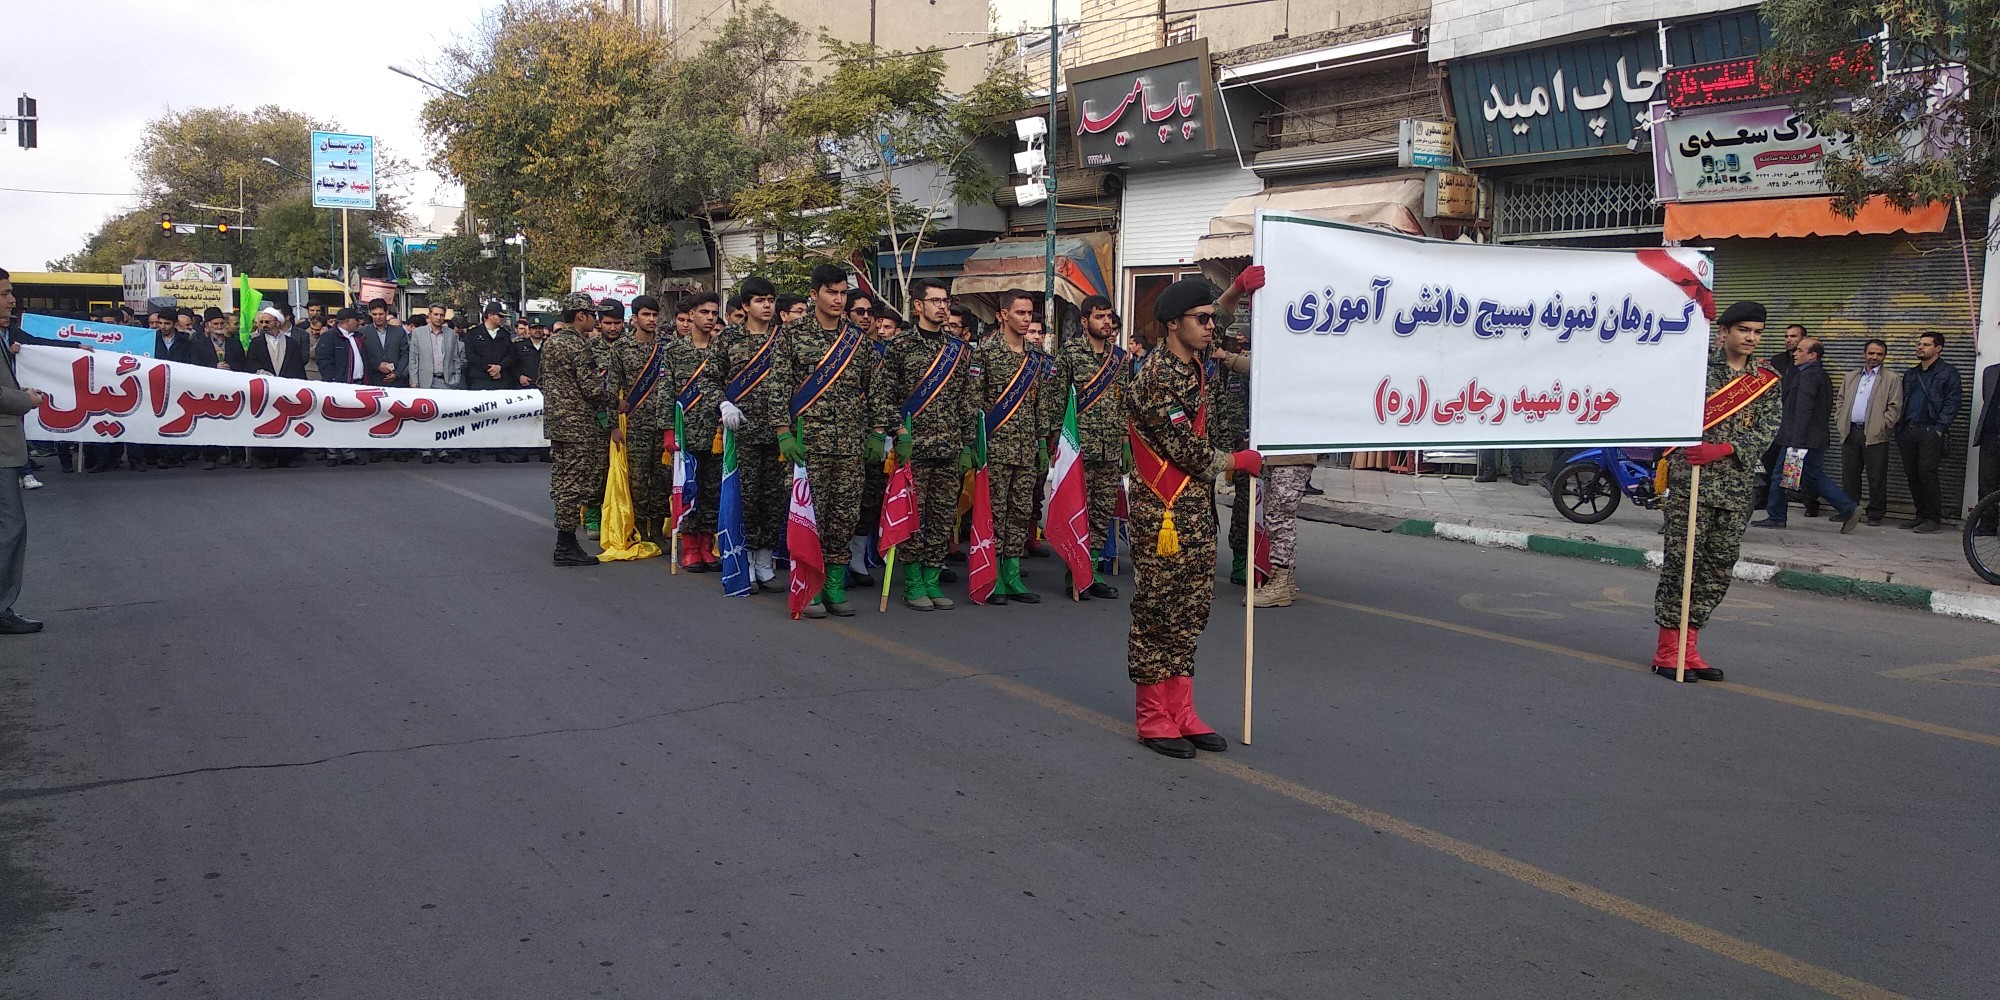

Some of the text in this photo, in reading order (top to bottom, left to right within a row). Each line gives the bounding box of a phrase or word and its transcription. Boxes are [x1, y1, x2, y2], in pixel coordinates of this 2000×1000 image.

[1484, 56, 1662, 138] چاپ امید
[1076, 77, 1197, 147] چاپ امید
[320, 138, 366, 155] دبیرستان
[1680, 126, 1768, 158] سعدی
[328, 159, 358, 171] شاهد
[1759, 151, 1820, 163] مهر فوری نیم ساعته
[316, 177, 371, 194] شهید خوشنام
[163, 283, 222, 292] پشتیبان ولایت فقیه
[580, 283, 637, 297] مدرسه راهنمایی
[203, 292, 221, 302] باشید
[1285, 276, 1696, 343] گروهان نمونه بسیج دانش آموزی
[58, 325, 123, 343] دبیرستان
[38, 355, 439, 439] مرگ بر اسرائیل
[1373, 375, 1622, 425] حوزه شهید رجایی (ره)
[441, 408, 470, 419] DOWN
[435, 425, 465, 442] DOWN
[507, 408, 544, 421] ISRAEL
